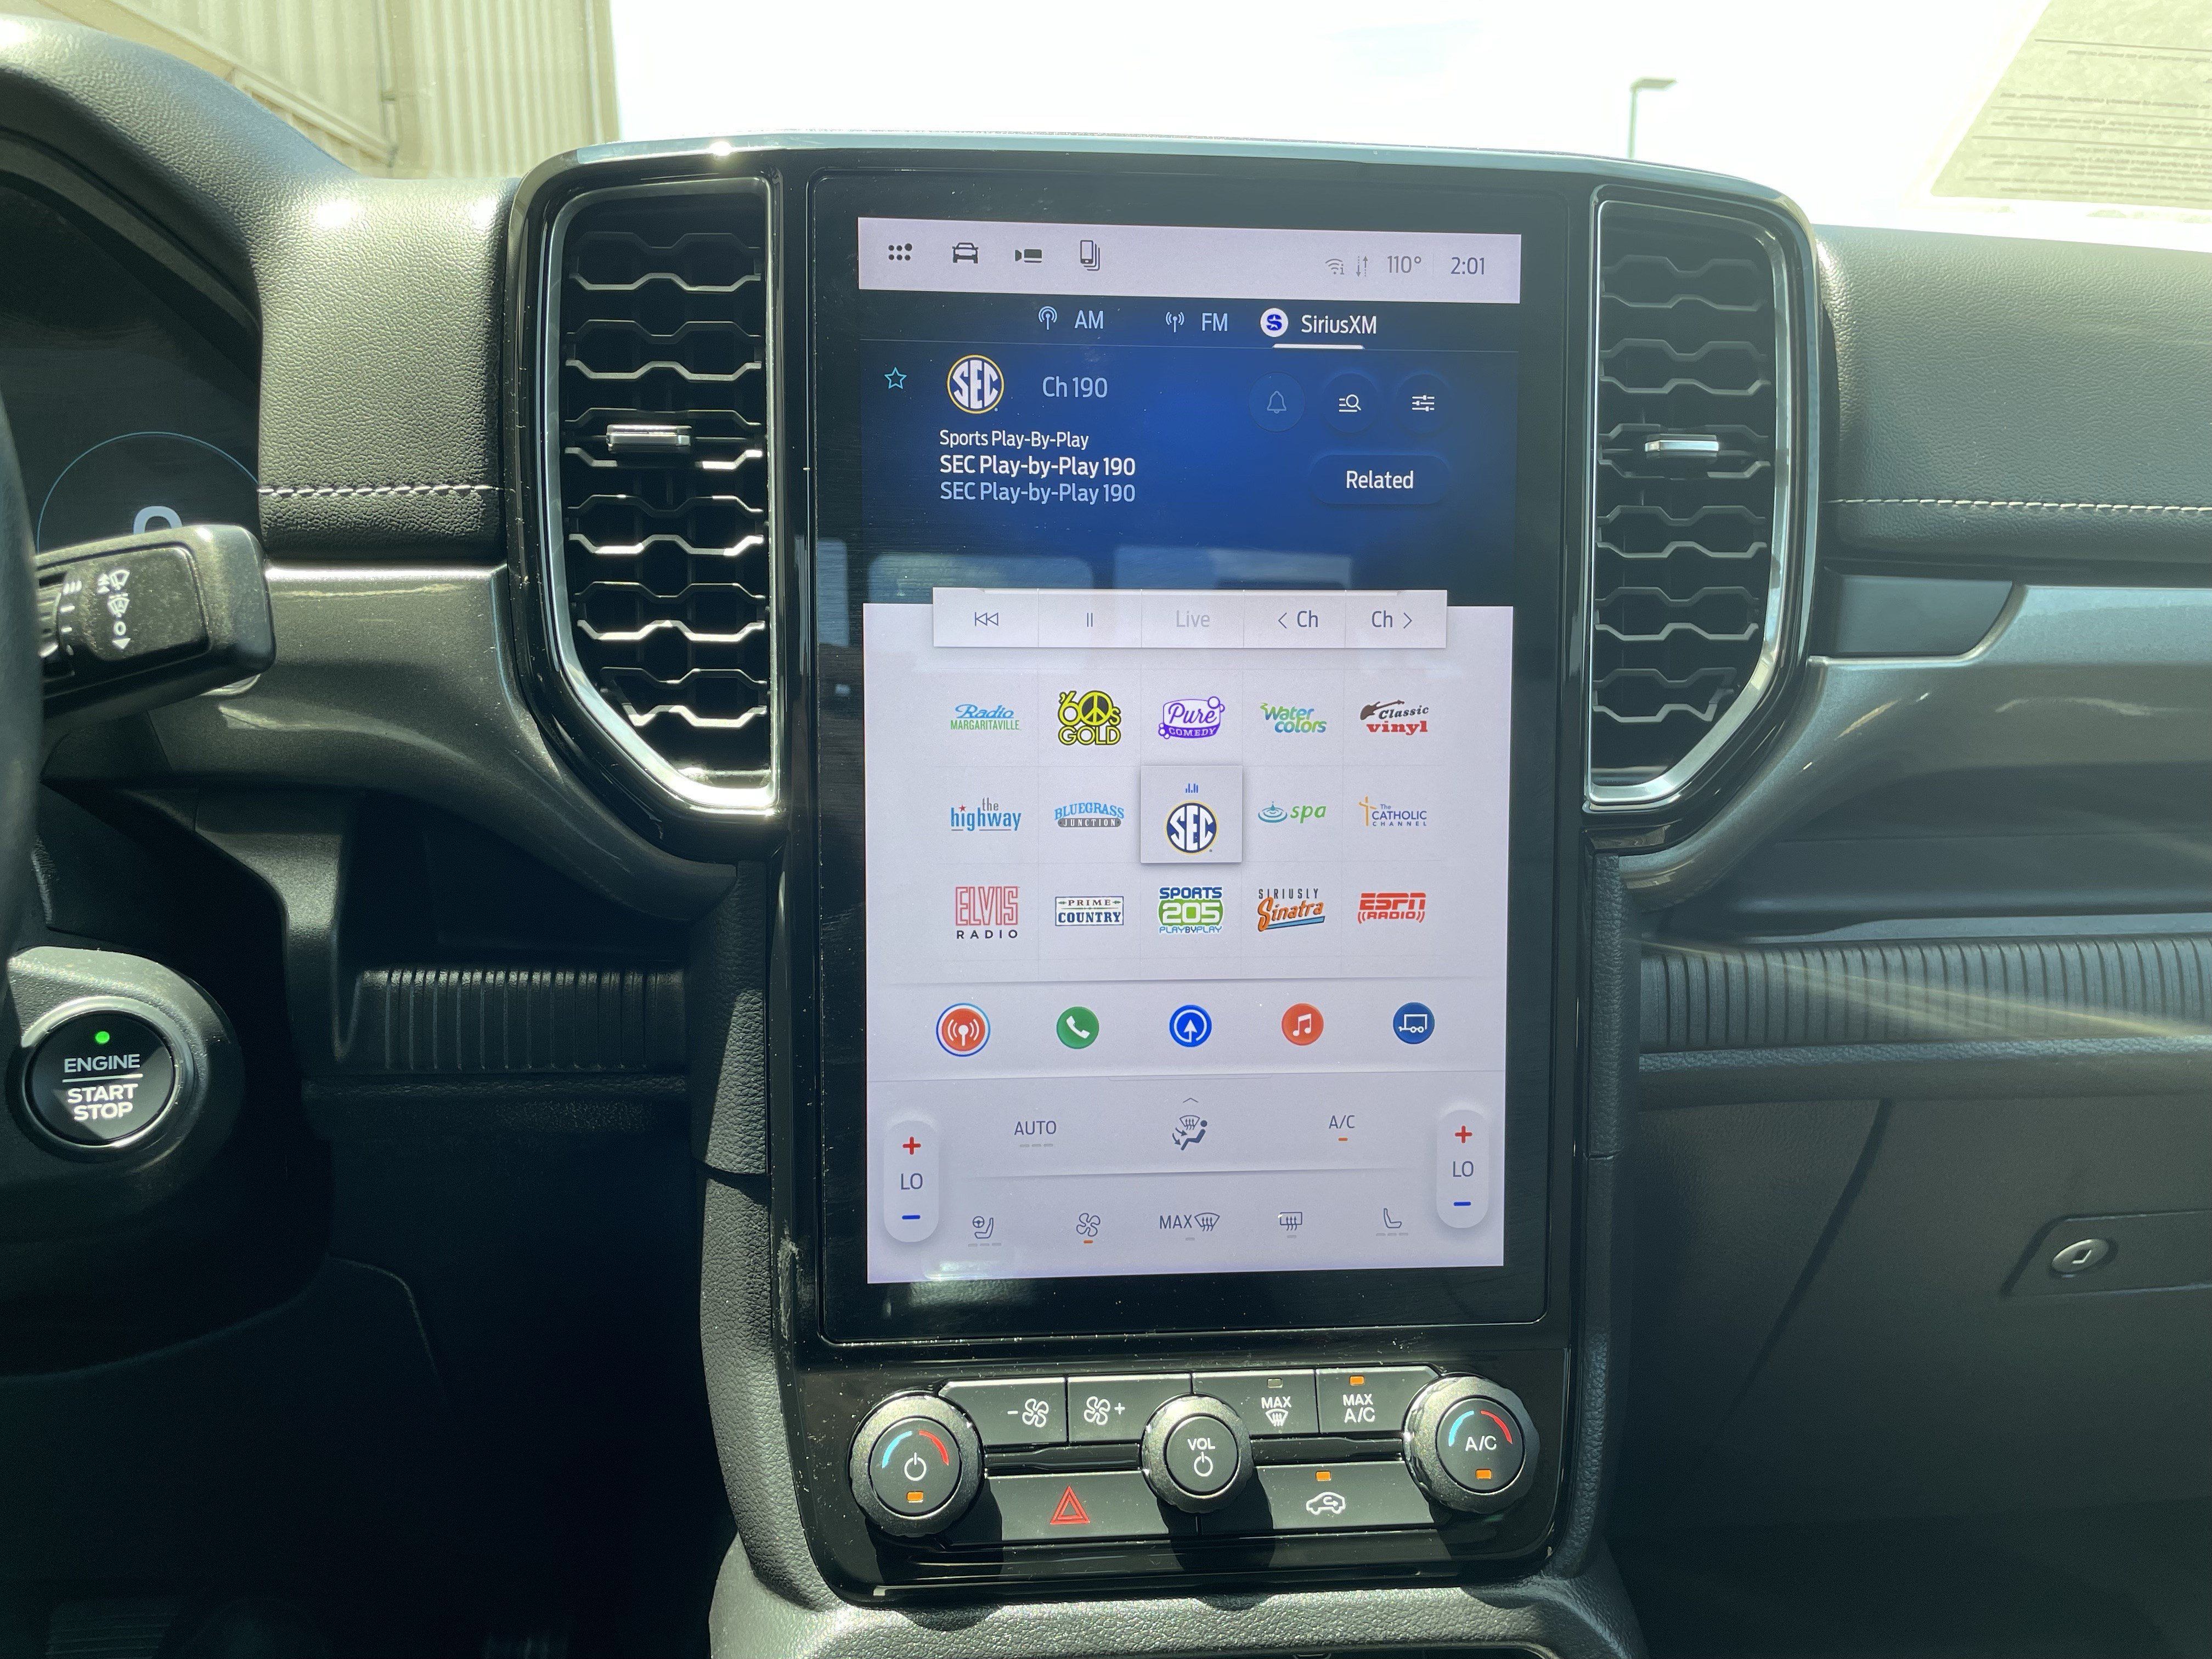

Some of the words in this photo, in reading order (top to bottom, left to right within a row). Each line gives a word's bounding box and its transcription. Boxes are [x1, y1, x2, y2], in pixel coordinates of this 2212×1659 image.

[1451, 256, 1486, 275] 2:01
[1074, 310, 1104, 329] AM
[1201, 313, 1228, 332] FM
[1301, 314, 1378, 335] SiriusXM
[952, 359, 999, 409] SEC
[1042, 376, 1068, 397] Ch
[1073, 377, 1108, 398] 190
[939, 430, 988, 449] Sports
[991, 430, 1089, 450] Play-By-Play
[940, 455, 975, 473] SEC
[980, 455, 1099, 479] Play-by-Play
[1103, 457, 1136, 476] 190
[1345, 470, 1414, 489] Related
[940, 481, 976, 500] SEC
[980, 482, 1099, 505] Play-by-Play
[1104, 483, 1136, 503] 190
[1176, 610, 1210, 628] Live
[1296, 610, 1318, 628] Ch
[1372, 610, 1393, 628] Ch
[955, 704, 1014, 719] Radio
[1168, 702, 1217, 724] Pure
[1260, 702, 1314, 721] Water
[1379, 704, 1429, 720] Classic
[950, 719, 1020, 730] MARGARITAVILLE
[1168, 727, 1217, 737] COMEDY
[1274, 717, 1327, 733] colors
[1366, 720, 1429, 736] vinyl
[1058, 725, 1121, 746] GOLD
[982, 797, 999, 811] the
[1054, 802, 1125, 821] BLUEGRASS
[951, 804, 1022, 832] highway
[1063, 818, 1117, 827] JUNCTION
[1290, 804, 1327, 823] spa
[1372, 810, 1427, 820] CATHOLIC
[1170, 804, 1214, 851] SEC
[1159, 887, 1223, 899] SPORTS
[1258, 888, 1319, 899] SIRIUSLY
[1359, 892, 1426, 911] ESPN
[955, 885, 1018, 926] ELVIS
[1162, 901, 1220, 923] 205
[1257, 897, 1325, 932] Sinatra
[1058, 911, 1122, 923] COUNTRY
[1366, 911, 1415, 919] RADIO
[956, 929, 1018, 939] RADIO
[64, 1053, 140, 1073] ENGINE
[67, 1083, 138, 1104] START
[74, 1102, 133, 1121] STOP
[1014, 1120, 1057, 1136] AUTO
[1328, 1114, 1356, 1129] A/C
[1452, 1161, 1474, 1178] LO
[900, 1172, 923, 1190] LO
[1159, 1214, 1193, 1229] MAX
[1261, 1396, 1292, 1409] MAX
[1342, 1393, 1374, 1407] MAX
[1344, 1407, 1375, 1423] A/C
[1187, 1437, 1216, 1452] VOL
[1465, 1435, 1498, 1452] A/C
